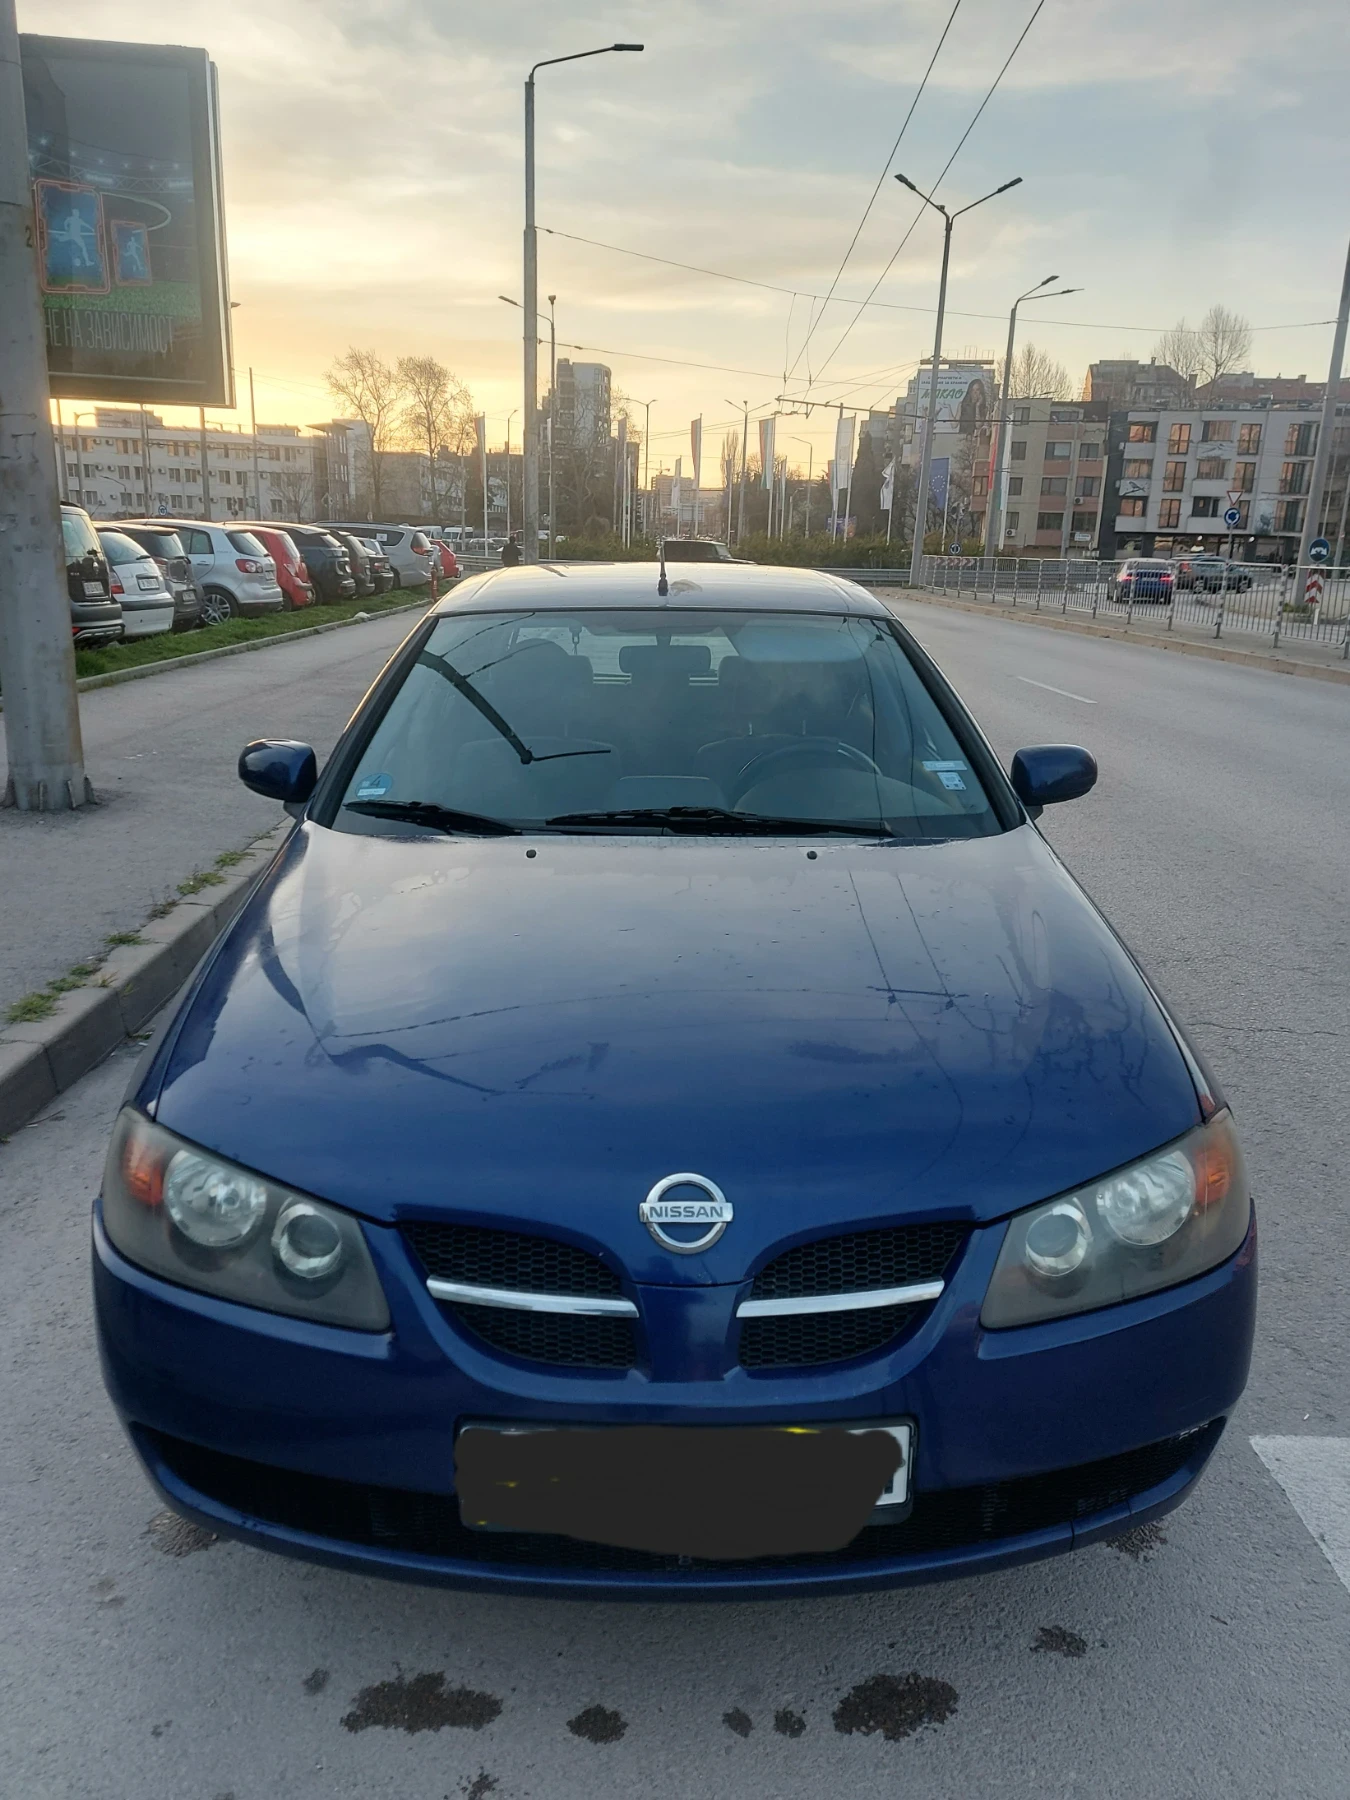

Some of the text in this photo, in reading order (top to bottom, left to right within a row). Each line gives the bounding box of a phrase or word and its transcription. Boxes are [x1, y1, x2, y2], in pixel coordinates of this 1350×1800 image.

[63, 308, 83, 348] НА
[85, 310, 174, 353] ЗАВИСИМОСТ
[370, 775, 382, 787] 4
[649, 1206, 723, 1218] NISSAN
